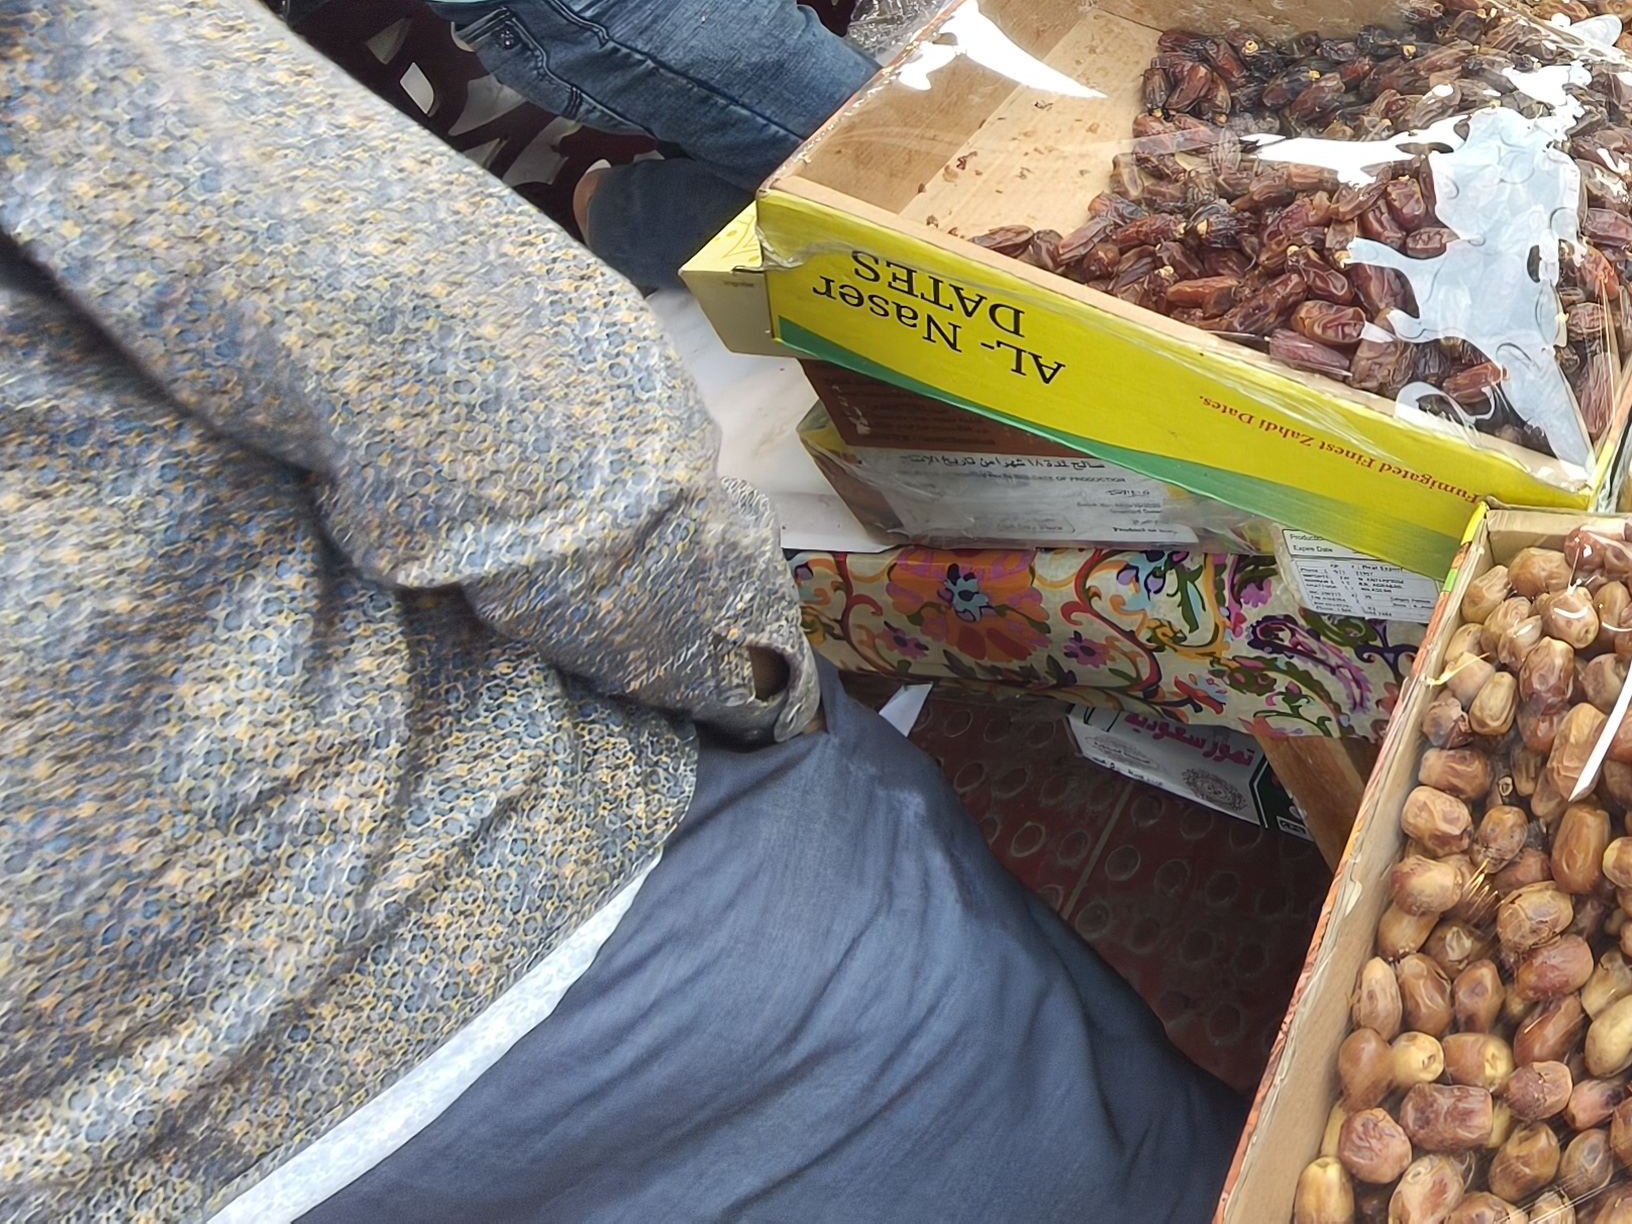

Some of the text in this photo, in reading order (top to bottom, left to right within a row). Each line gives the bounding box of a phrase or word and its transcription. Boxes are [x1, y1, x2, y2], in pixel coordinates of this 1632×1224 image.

[813, 275, 1066, 384] AL- Naser
[851, 250, 1025, 338] DATES
[1199, 395, 1480, 504] Fumigated Finest Zahdi Dates.
